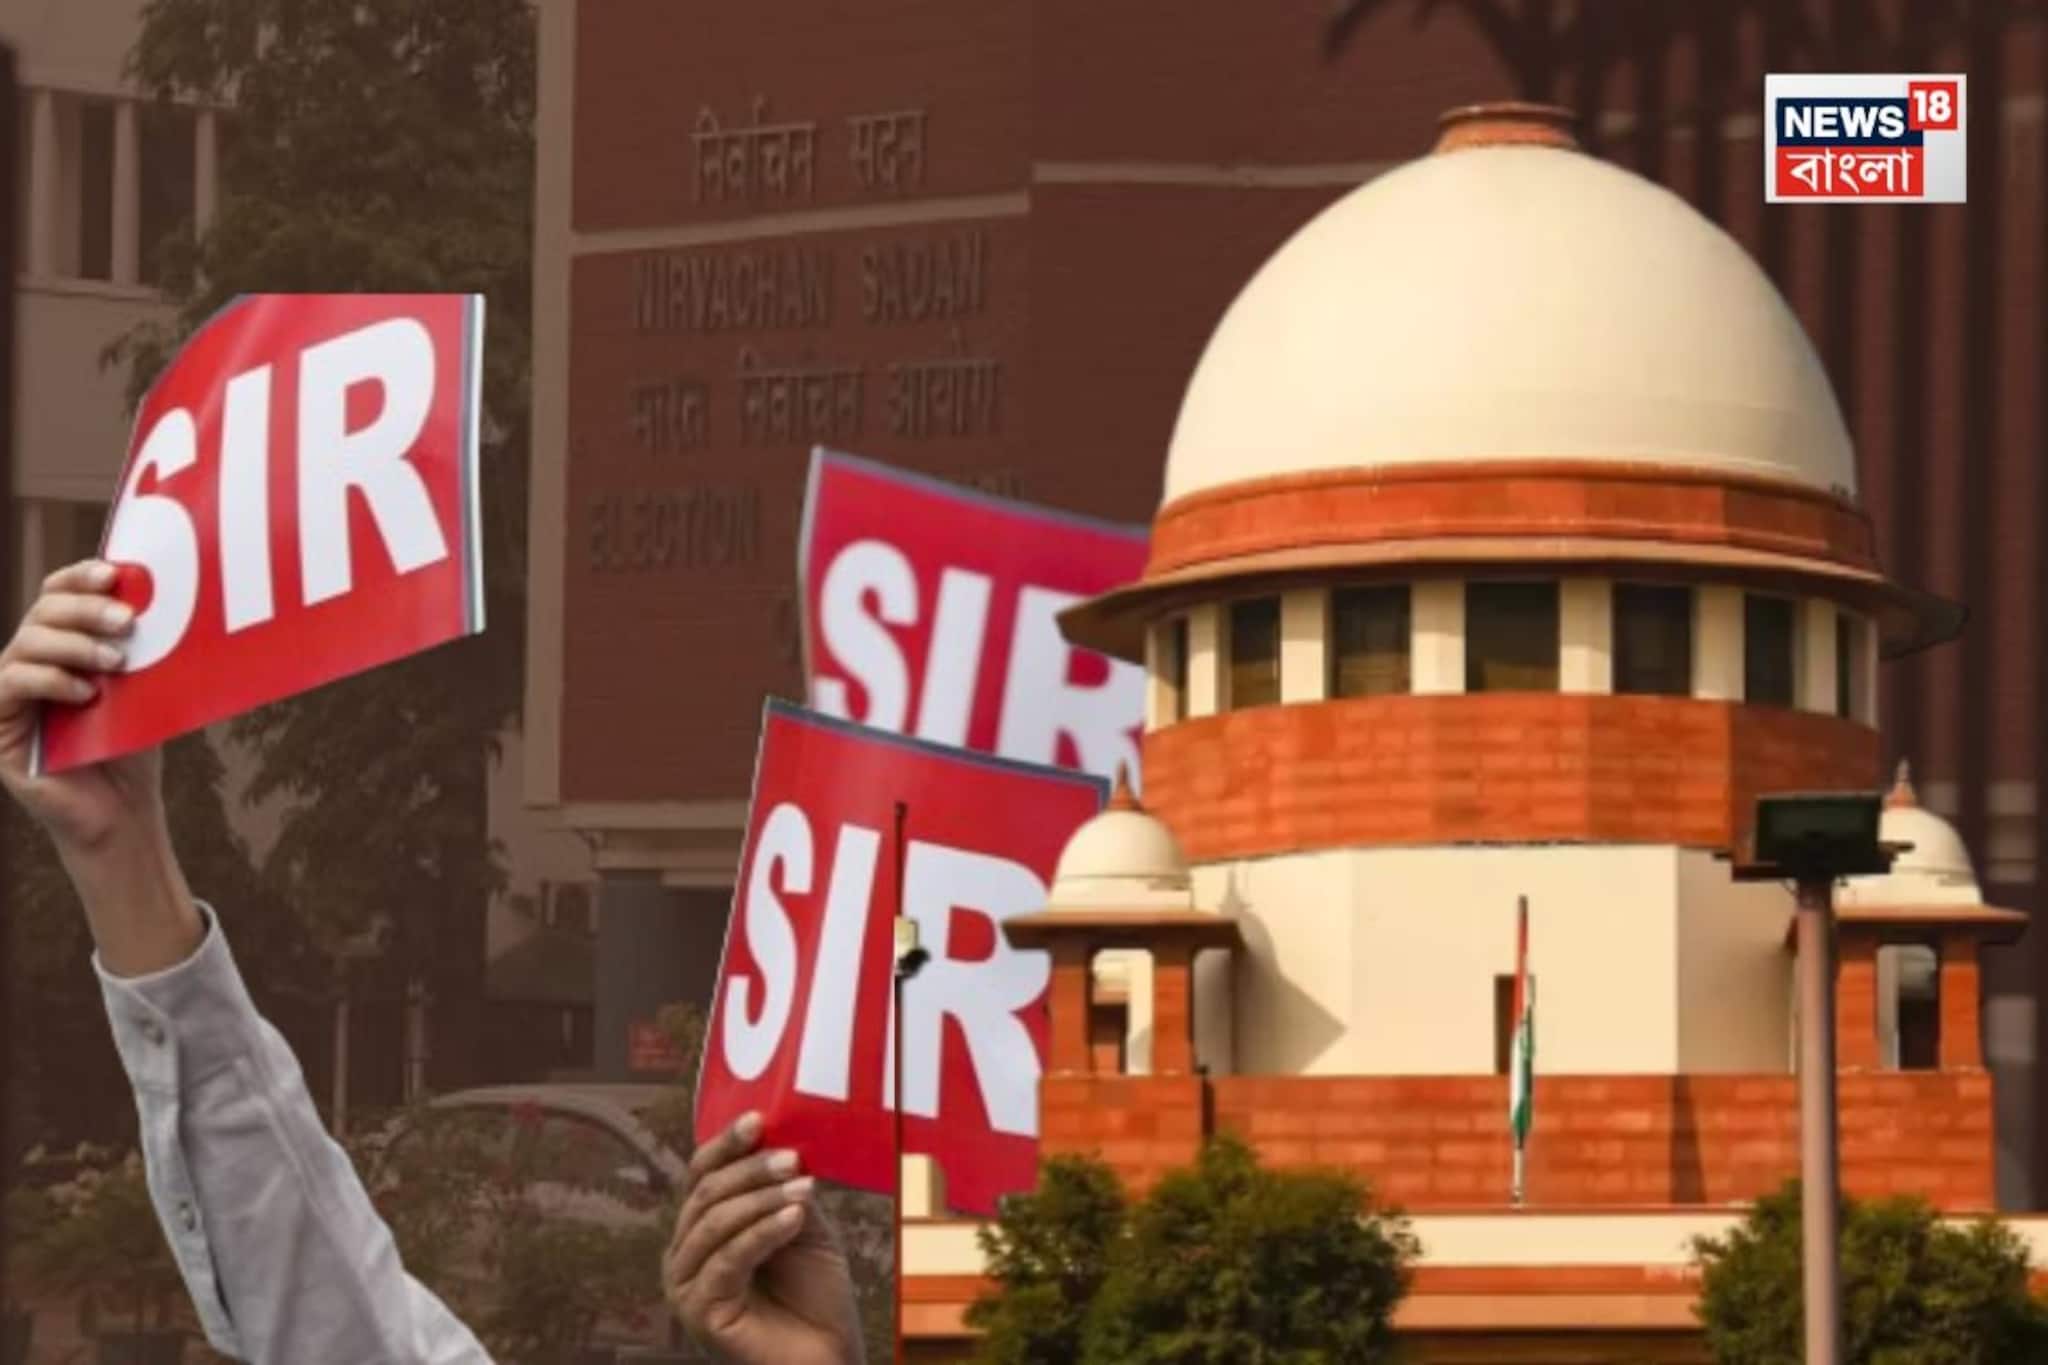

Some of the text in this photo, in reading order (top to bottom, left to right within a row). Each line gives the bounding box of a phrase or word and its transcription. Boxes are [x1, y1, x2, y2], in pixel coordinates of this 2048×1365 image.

[690, 94, 928, 199] निर्वाचन सदन
[633, 230, 990, 330] NIRVACHAN SADAN
[103, 317, 448, 673] SIR
[812, 539, 1147, 799] SIR
[722, 803, 1053, 1138] SIR
